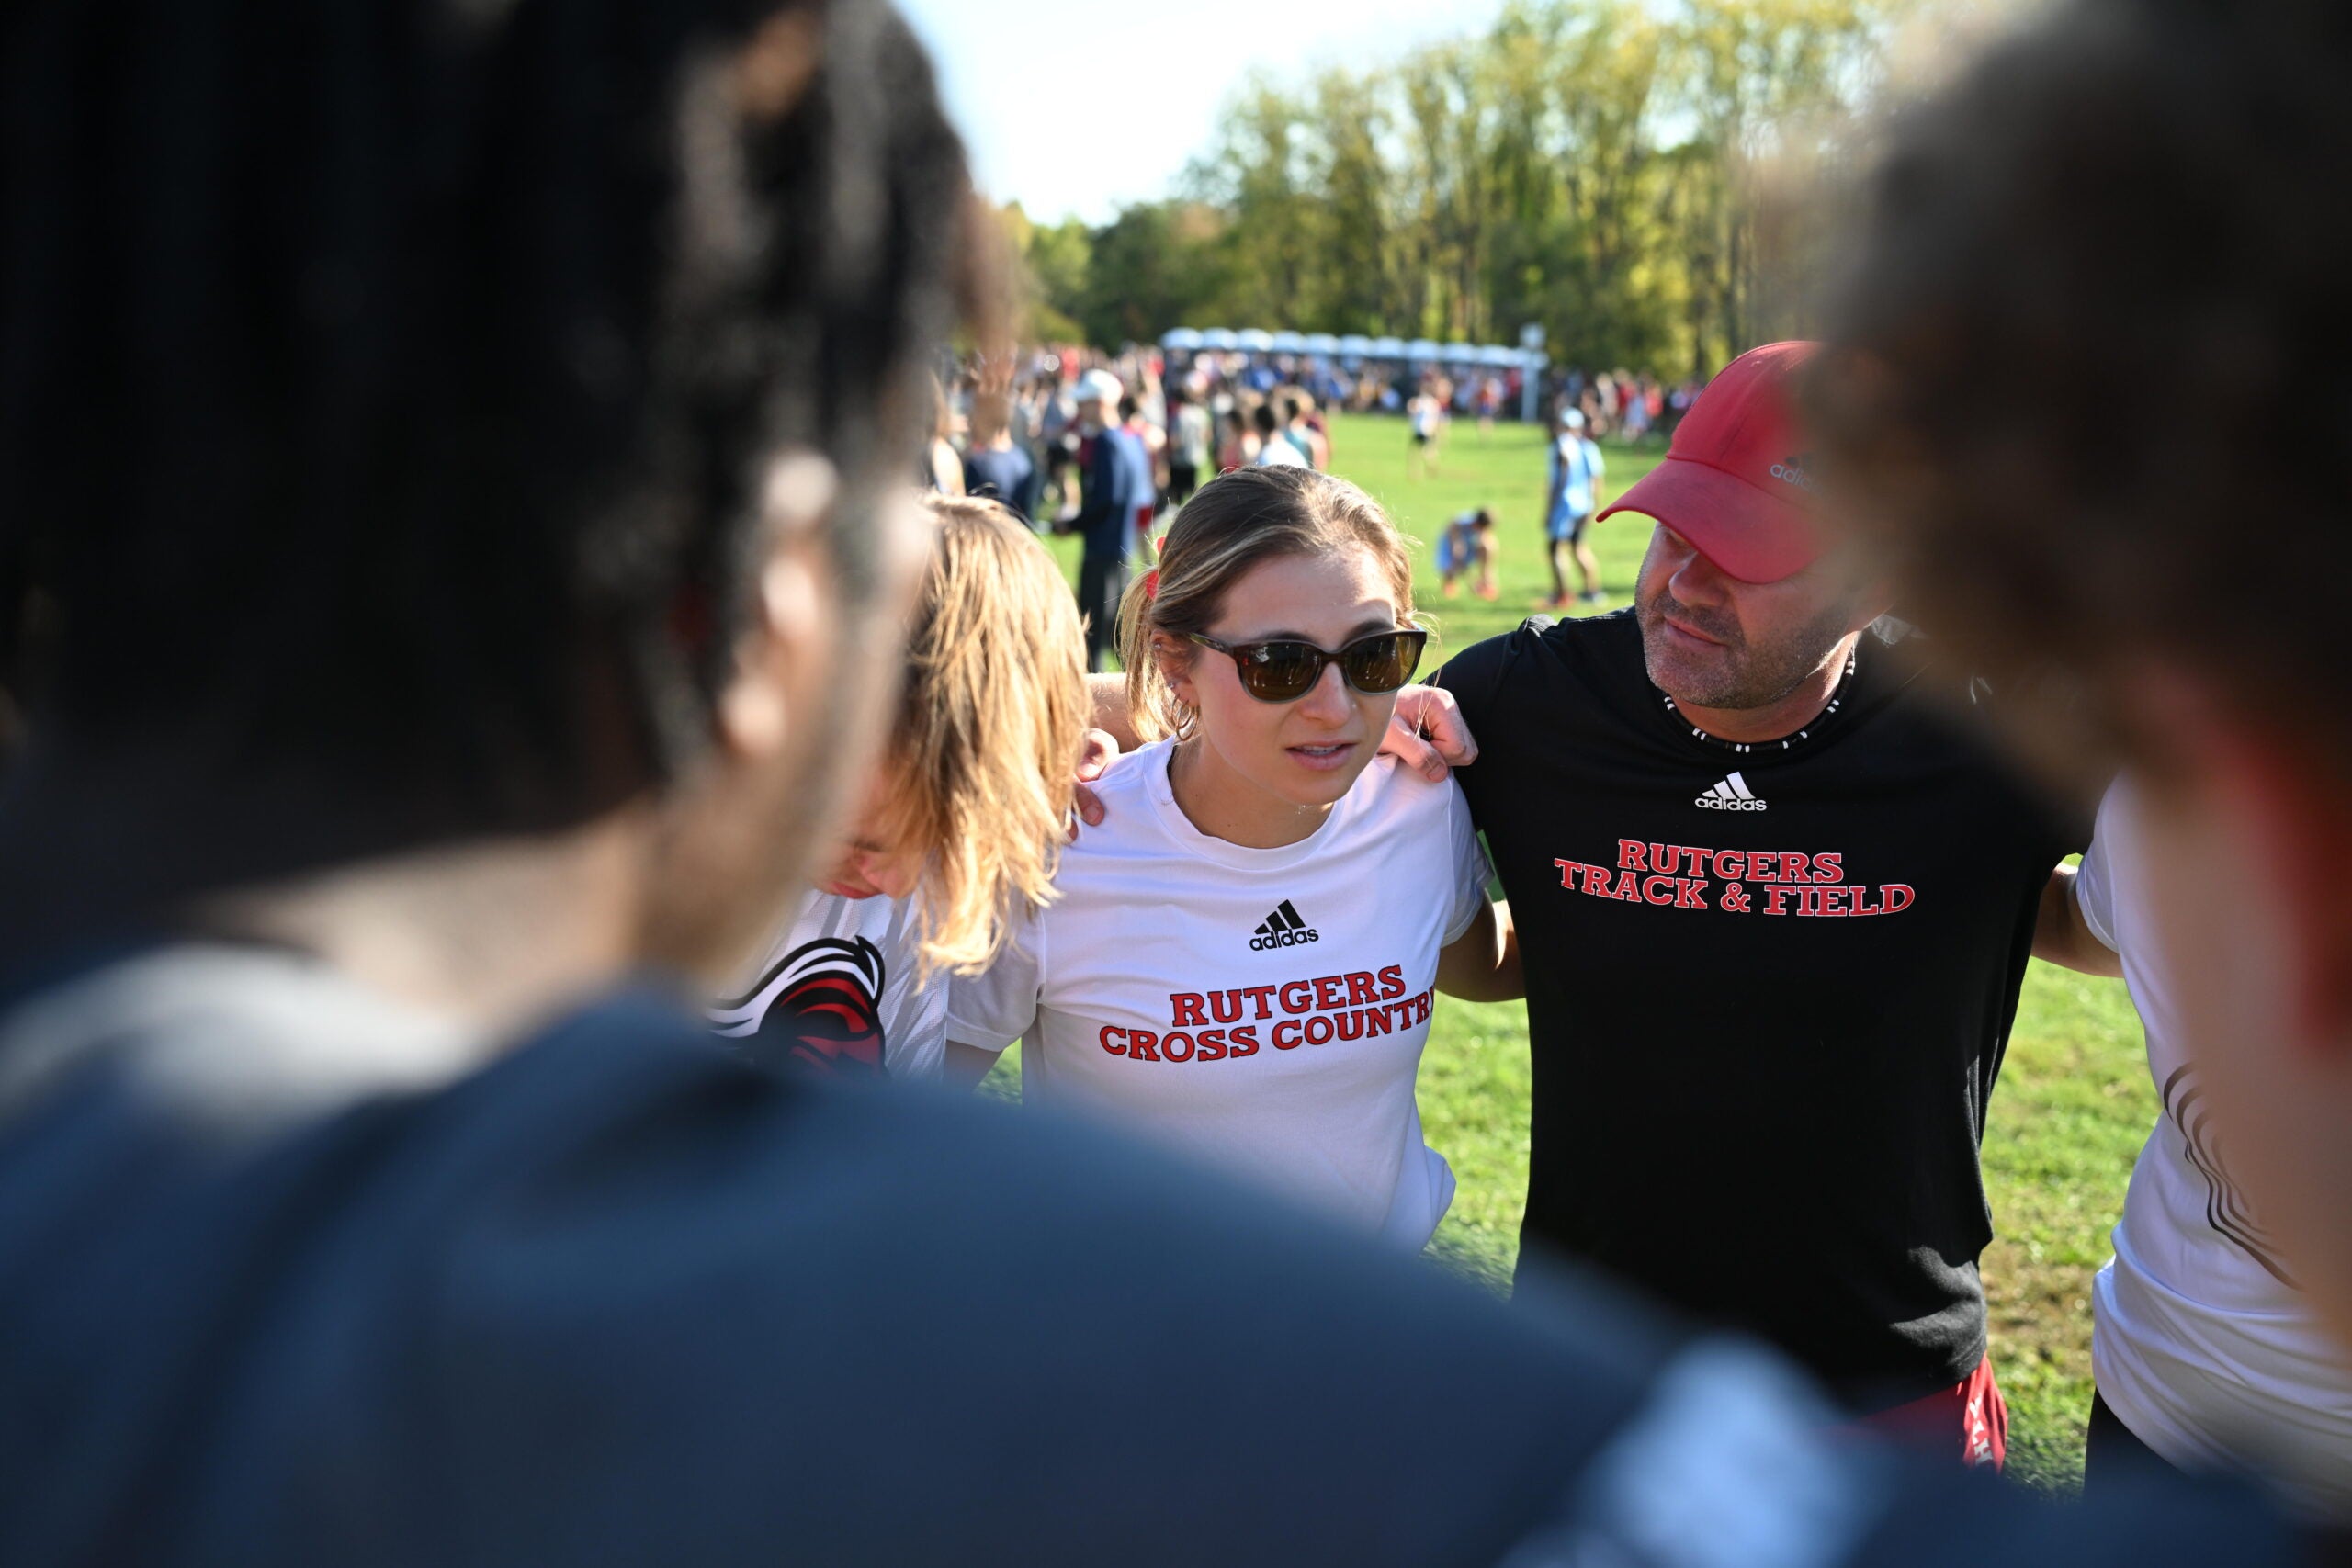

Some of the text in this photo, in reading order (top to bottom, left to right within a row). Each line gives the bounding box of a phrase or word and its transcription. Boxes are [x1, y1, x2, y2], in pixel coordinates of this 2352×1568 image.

[1770, 464, 1813, 491] adi
[1694, 796, 1768, 812] adidas
[1618, 839, 1845, 884] RUTGERS
[1554, 858, 1916, 918] TRACK & FIELD
[1250, 926, 1319, 952] adidas
[1170, 964, 1407, 1027] RUTGERS
[1099, 1025, 1259, 1063] CROSS
